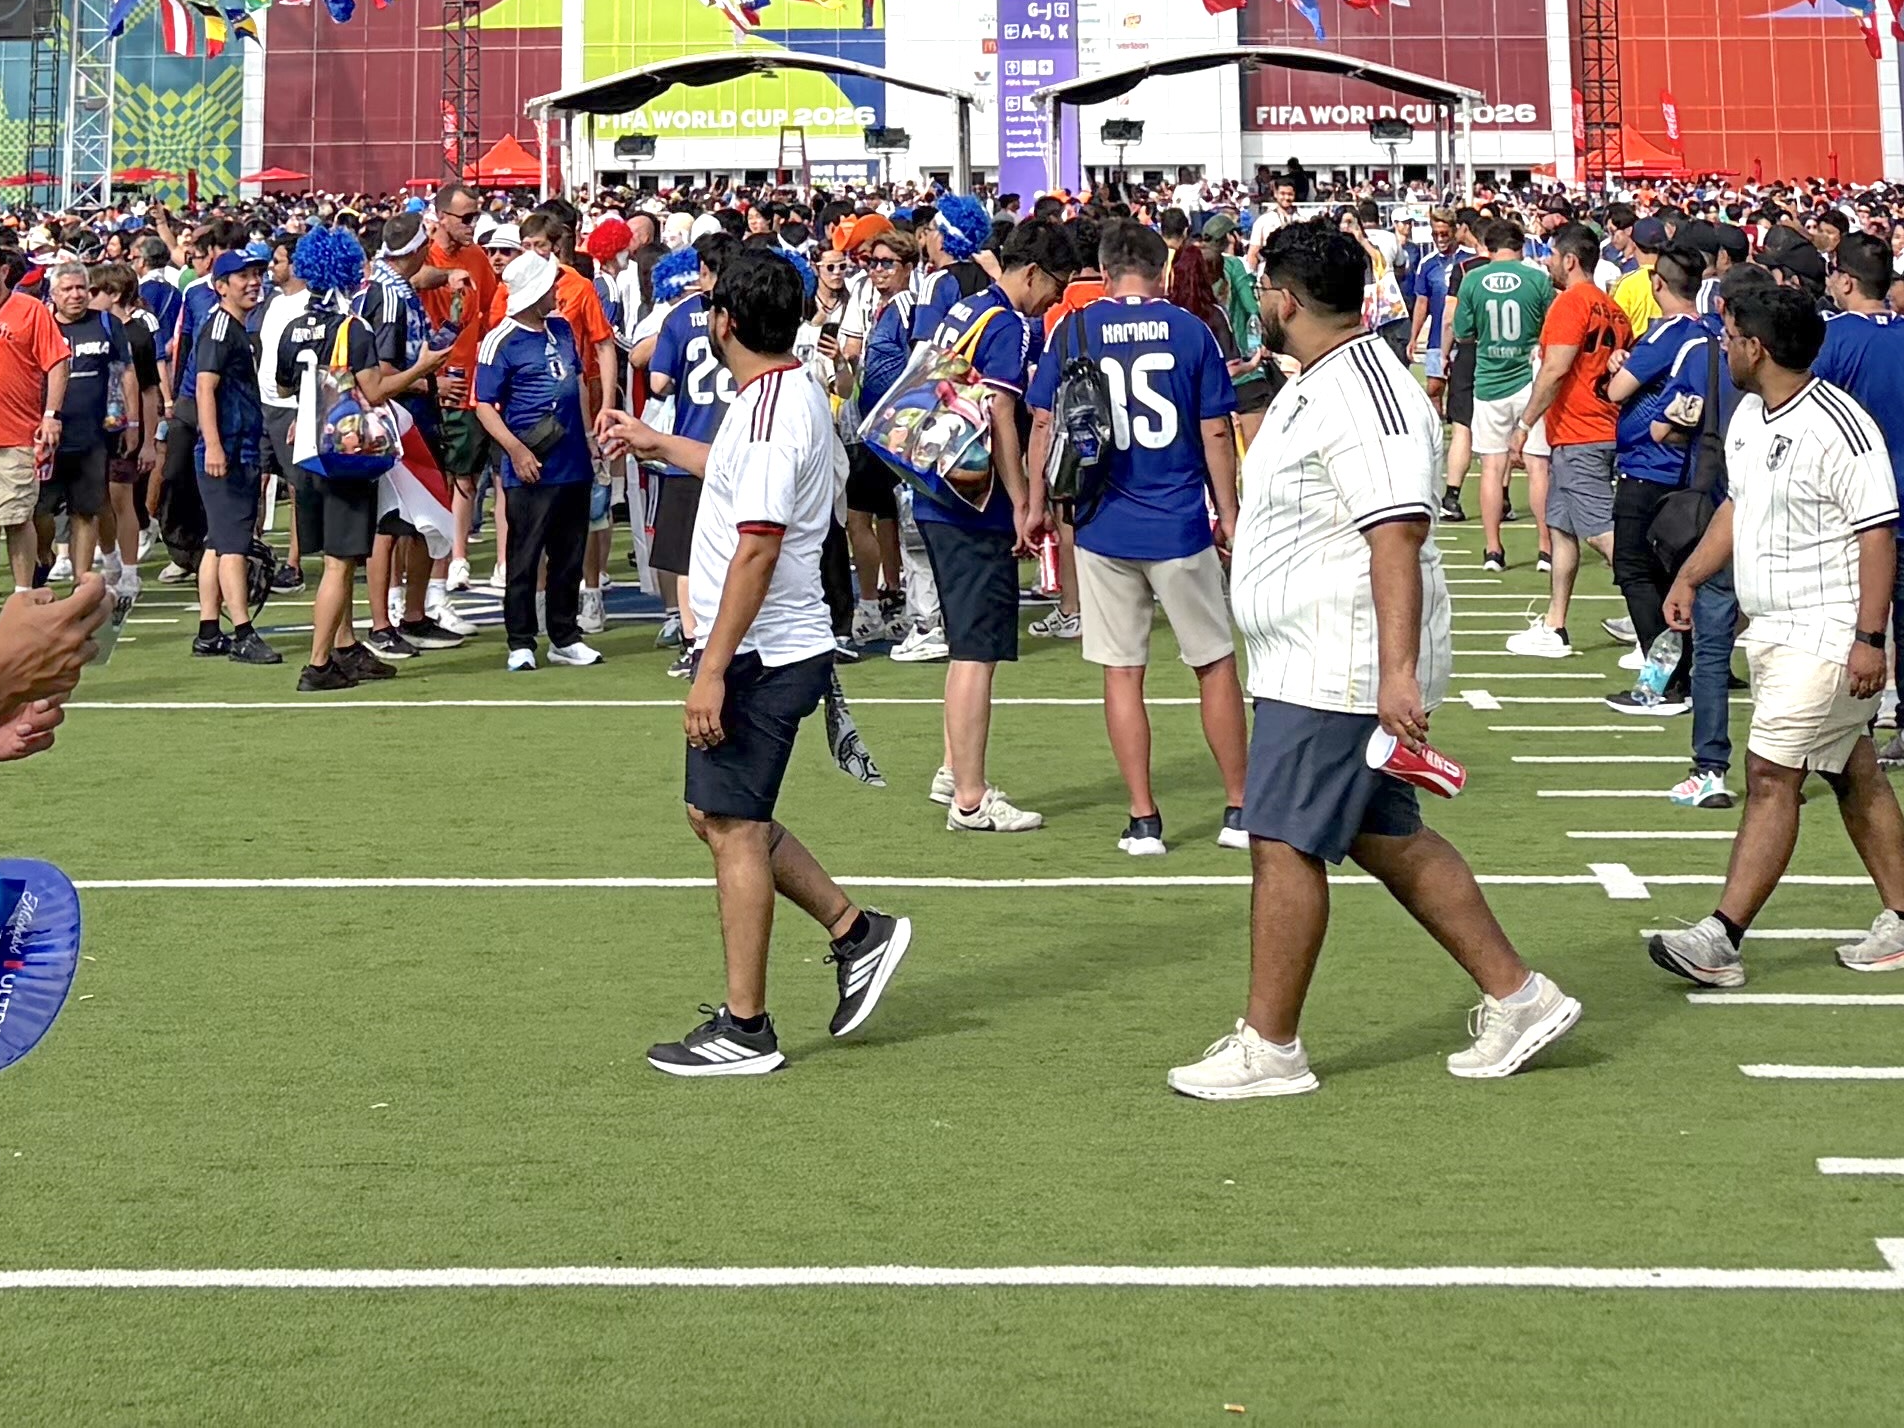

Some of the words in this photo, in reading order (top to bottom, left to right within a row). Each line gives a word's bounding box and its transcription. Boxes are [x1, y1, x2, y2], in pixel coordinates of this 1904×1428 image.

[1058, 24, 1069, 39] K
[599, 111, 647, 130] FIFA
[652, 110, 737, 129] WORLD
[741, 108, 787, 127] CUP
[792, 106, 877, 127] 2026
[1256, 105, 1308, 125] FIFA
[1489, 276, 1516, 288] KIA
[1101, 320, 1170, 344] KAMADA
[1485, 299, 1521, 342] 10
[1099, 352, 1178, 451] 15
